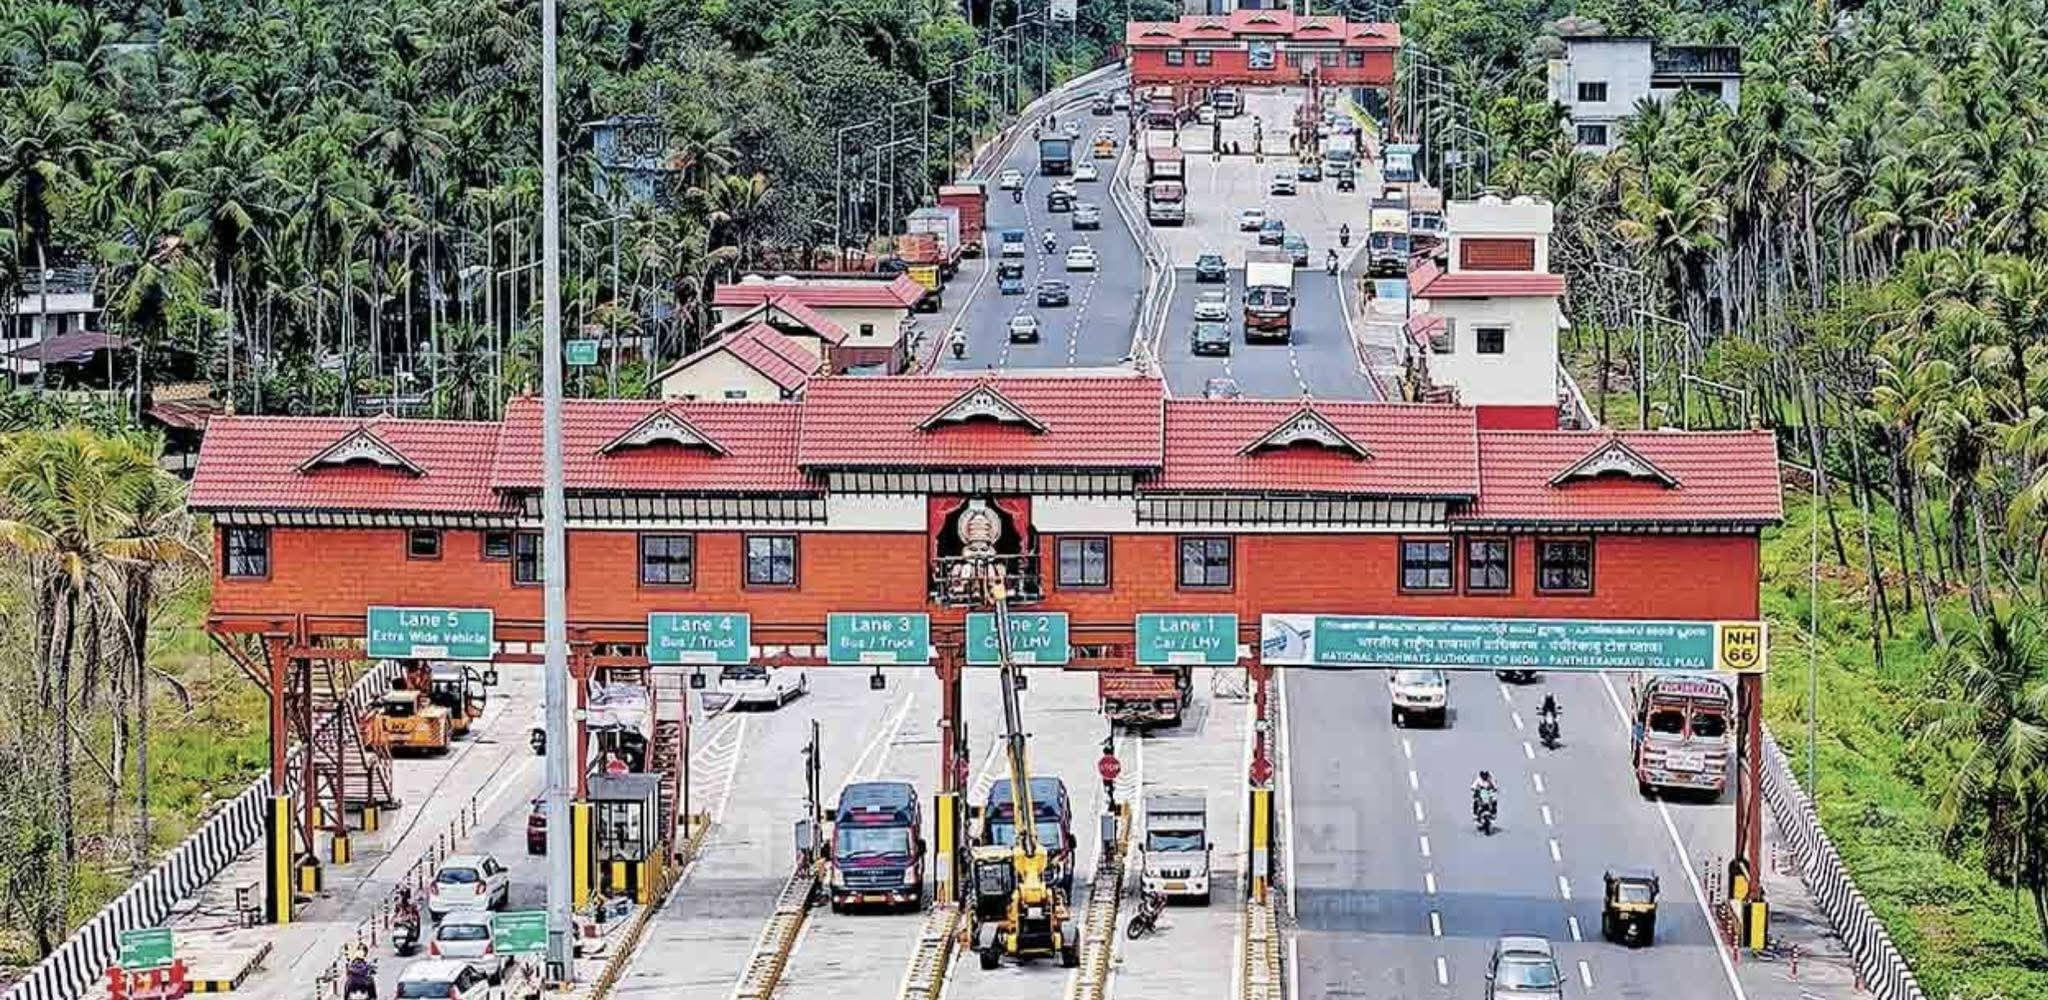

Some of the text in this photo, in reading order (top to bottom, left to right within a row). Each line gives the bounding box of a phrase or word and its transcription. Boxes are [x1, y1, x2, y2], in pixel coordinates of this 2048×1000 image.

[399, 611, 459, 628] Lane 5
[671, 616, 732, 632] Lane 4
[851, 616, 911, 632] Lane 3
[990, 616, 1050, 632] Lne 2
[1159, 617, 1215, 633] Lane 1
[372, 629, 487, 644] Extra Wide Vehicle
[660, 636, 686, 649] Bus
[700, 636, 736, 649] Truck
[840, 636, 866, 649] Bus
[879, 636, 914, 649] Truck
[1022, 636, 1051, 649] LMV
[1153, 637, 1177, 650] Car
[1192, 637, 1220, 650] LMV
[1727, 632, 1756, 646] NH
[1321, 651, 1371, 662] NATIONAL
[1375, 652, 1431, 663] HIGHWAYS
[1435, 653, 1490, 664] AUTHORITY
[1492, 656, 1508, 664] OF
[1510, 655, 1538, 665] INDIA
[1648, 656, 1671, 667] TOLL
[1674, 656, 1705, 667] PLAZA
[1727, 651, 1754, 662] 66
